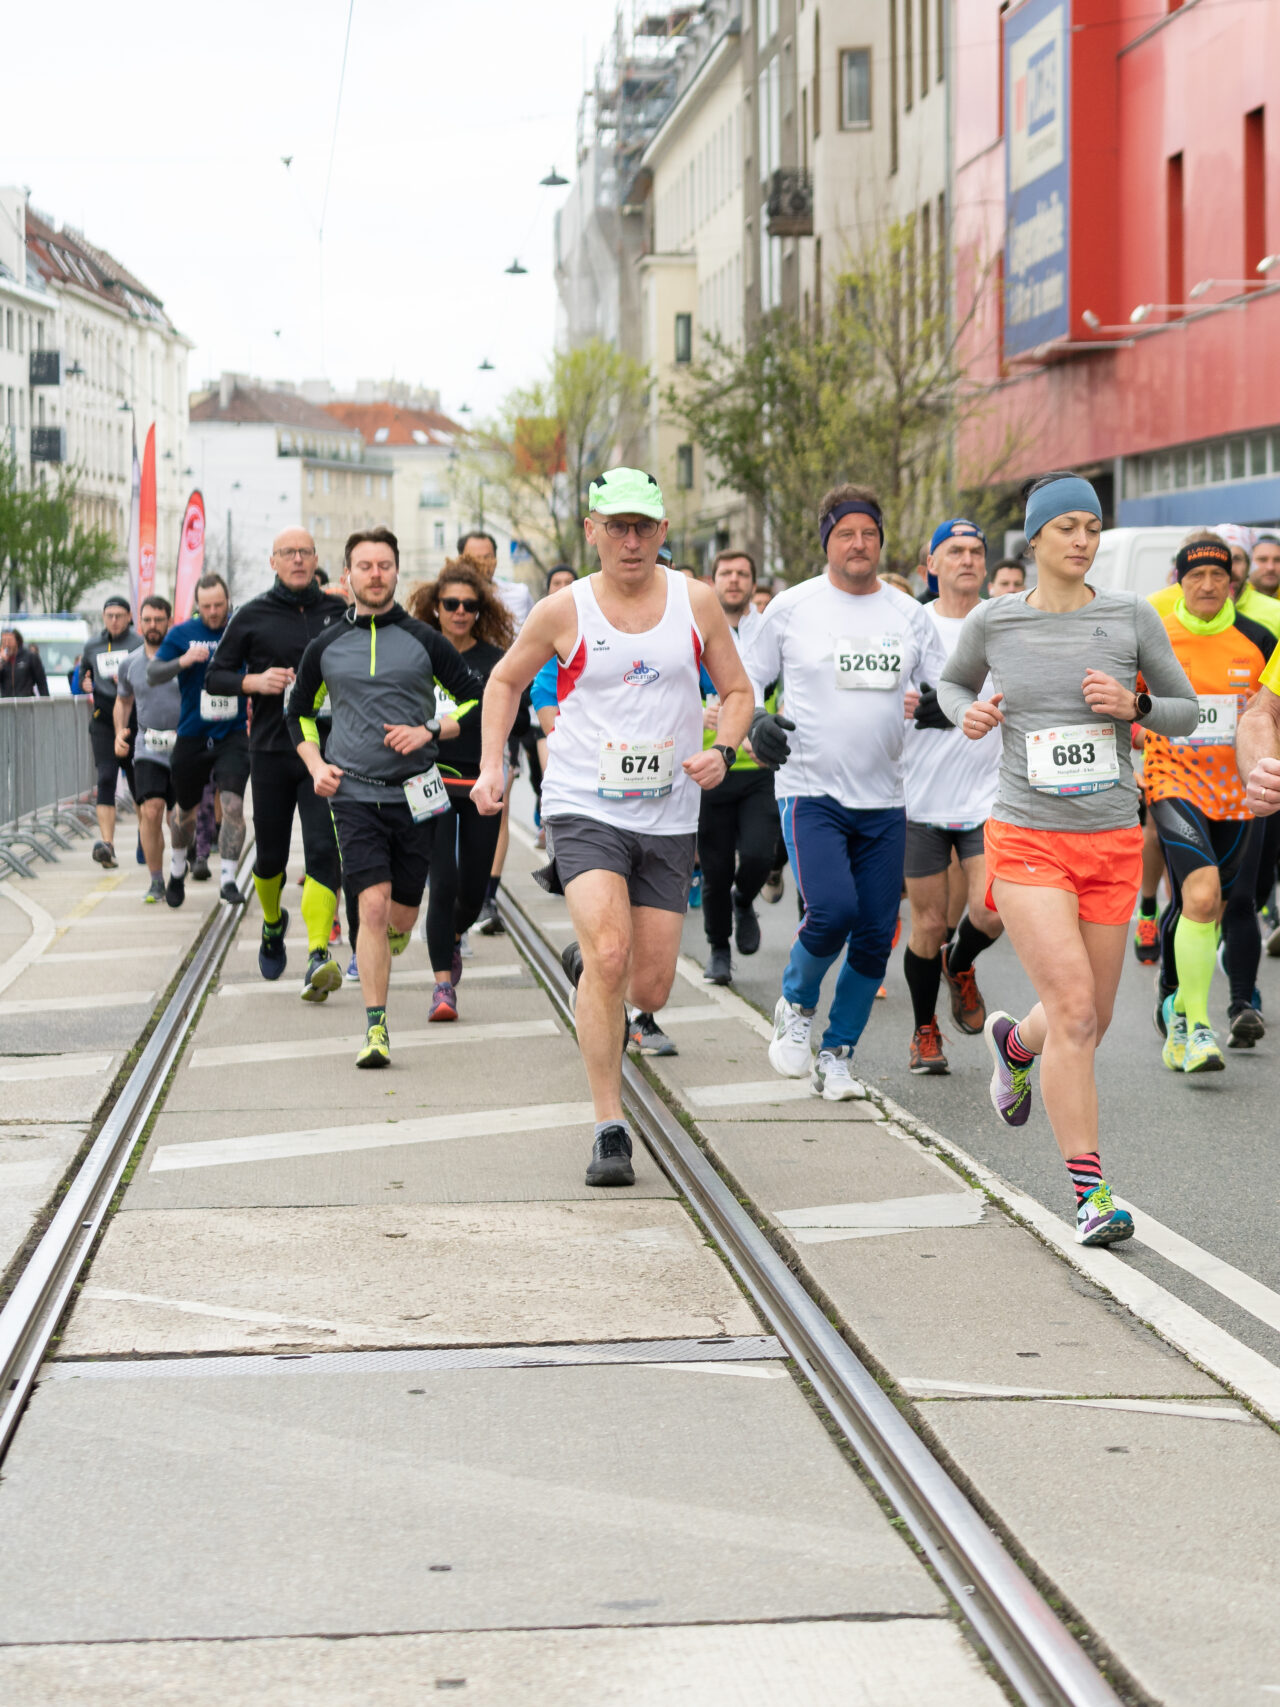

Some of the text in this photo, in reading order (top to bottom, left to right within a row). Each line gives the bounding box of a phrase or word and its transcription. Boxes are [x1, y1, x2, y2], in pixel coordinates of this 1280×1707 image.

[839, 653, 901, 672] 52632
[1052, 742, 1096, 766] 683
[621, 755, 660, 774] 674
